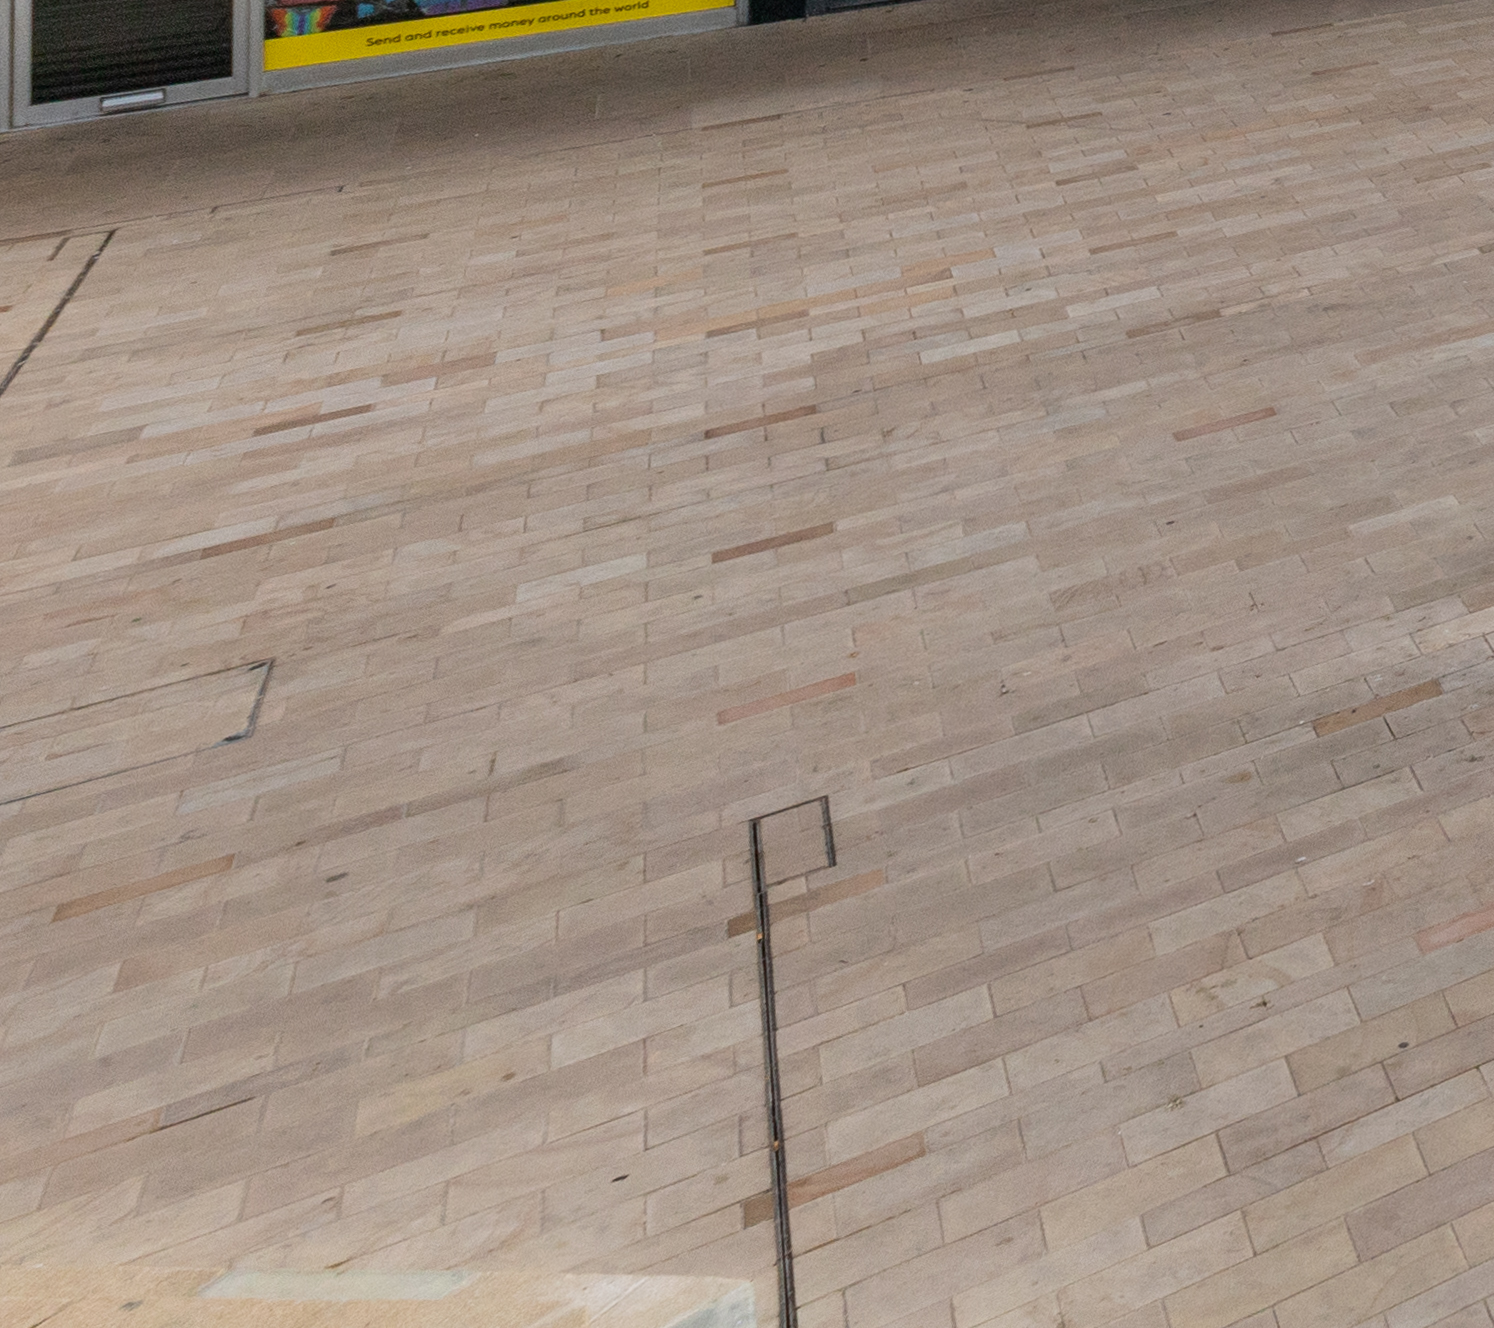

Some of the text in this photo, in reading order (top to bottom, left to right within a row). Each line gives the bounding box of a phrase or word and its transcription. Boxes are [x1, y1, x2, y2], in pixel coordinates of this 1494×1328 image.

[365, 0, 650, 47] Send and receive money around the world
